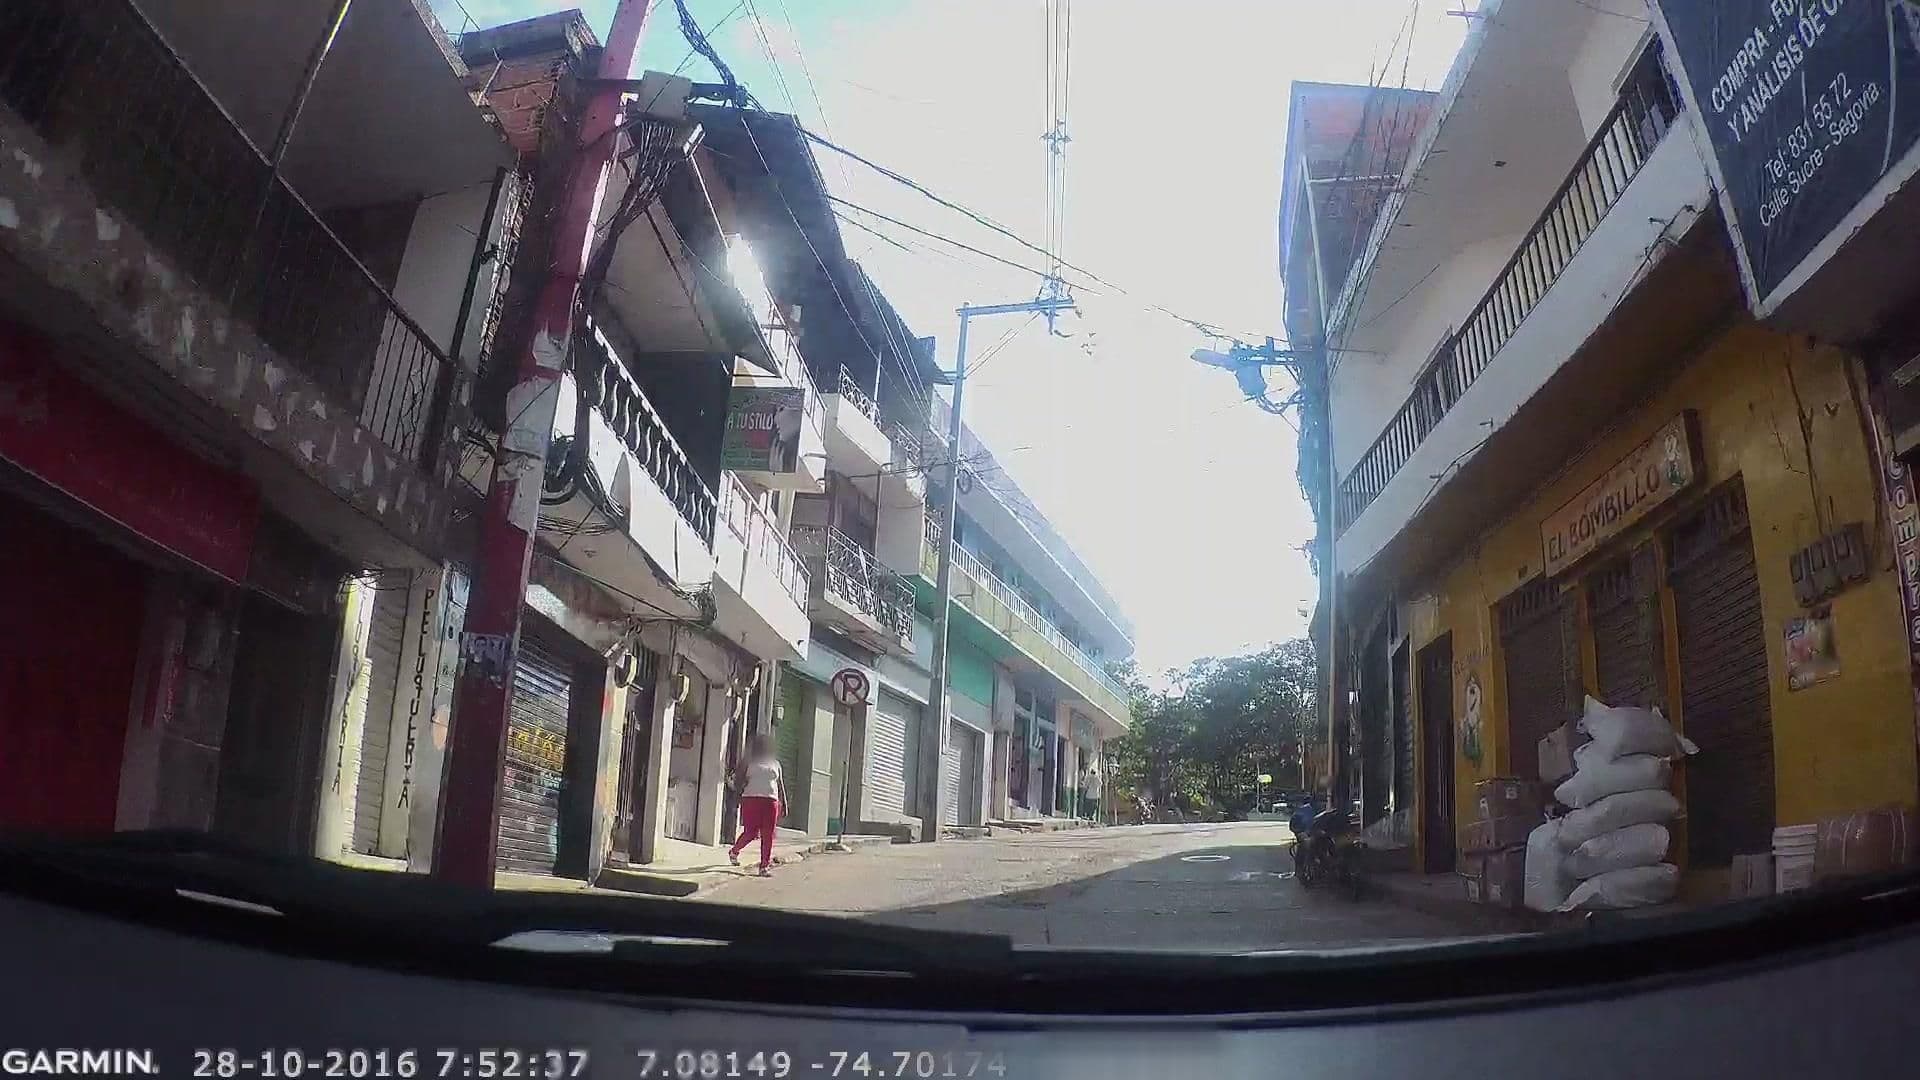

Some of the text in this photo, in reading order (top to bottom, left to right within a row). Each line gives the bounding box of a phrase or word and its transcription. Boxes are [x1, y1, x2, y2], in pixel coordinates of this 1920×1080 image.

[1711, 27, 1770, 113] COMPRA
[1727, 110, 1741, 142] Y
[1799, 1, 1826, 49] DE
[1787, 117, 1814, 159] 831
[1812, 93, 1832, 129] 55
[1828, 72, 1852, 107] 72
[1759, 186, 1790, 227] Calle
[1787, 148, 1824, 194] Sucre
[1828, 82, 1880, 146] Segovia
[1549, 531, 1564, 563] EL
[1569, 463, 1661, 546] BOMBILLO
[332, 590, 368, 796] LUQUERIA
[397, 588, 435, 809] PELUQUERIA
